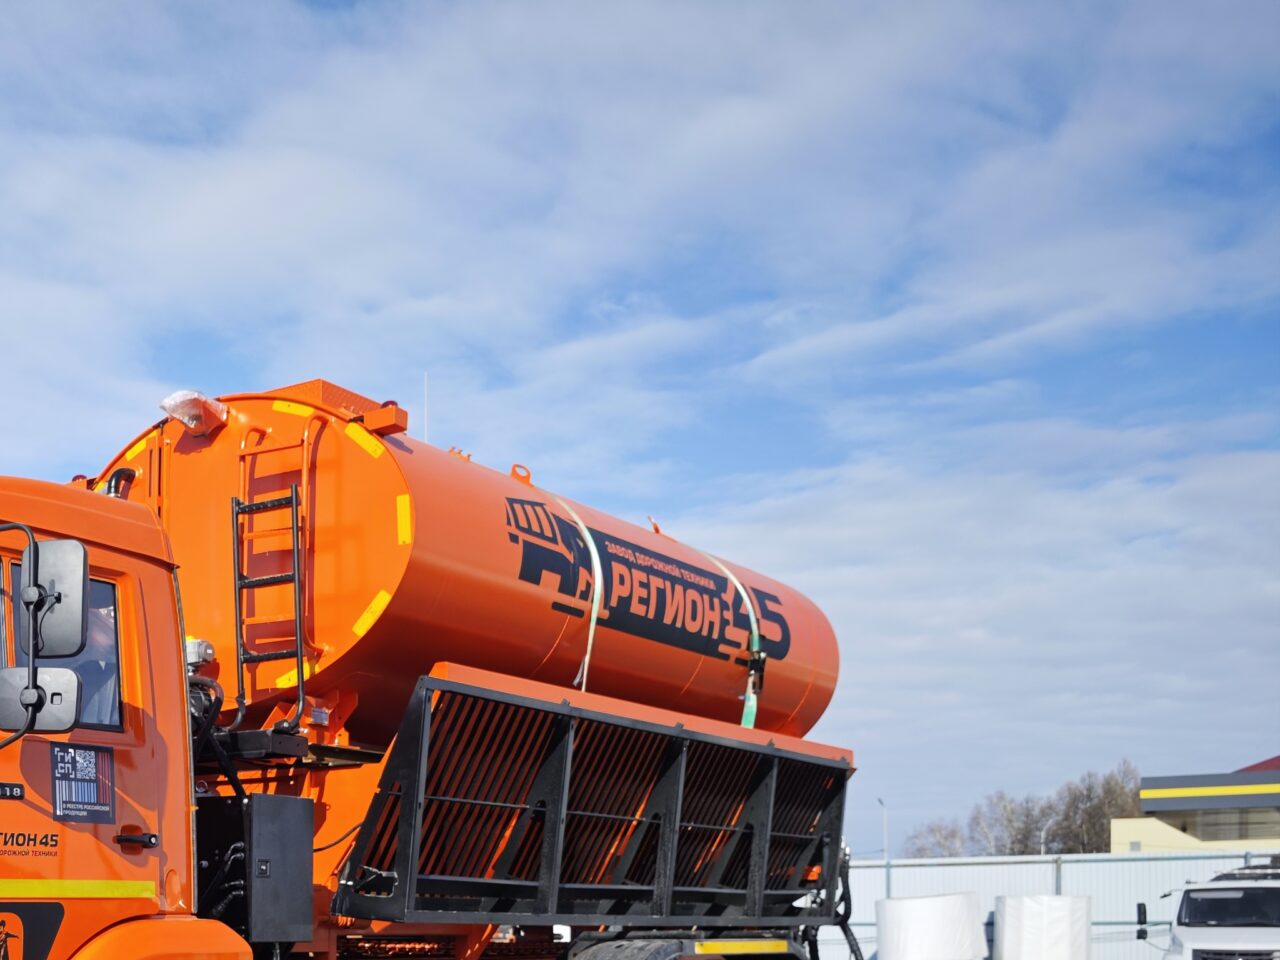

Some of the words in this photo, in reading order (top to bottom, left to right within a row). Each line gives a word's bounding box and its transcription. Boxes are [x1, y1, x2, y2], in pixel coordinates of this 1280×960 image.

[605, 541, 636, 563] ЗАВОД
[610, 561, 720, 640] РЕГИОН
[39, 833, 59, 848] 45
